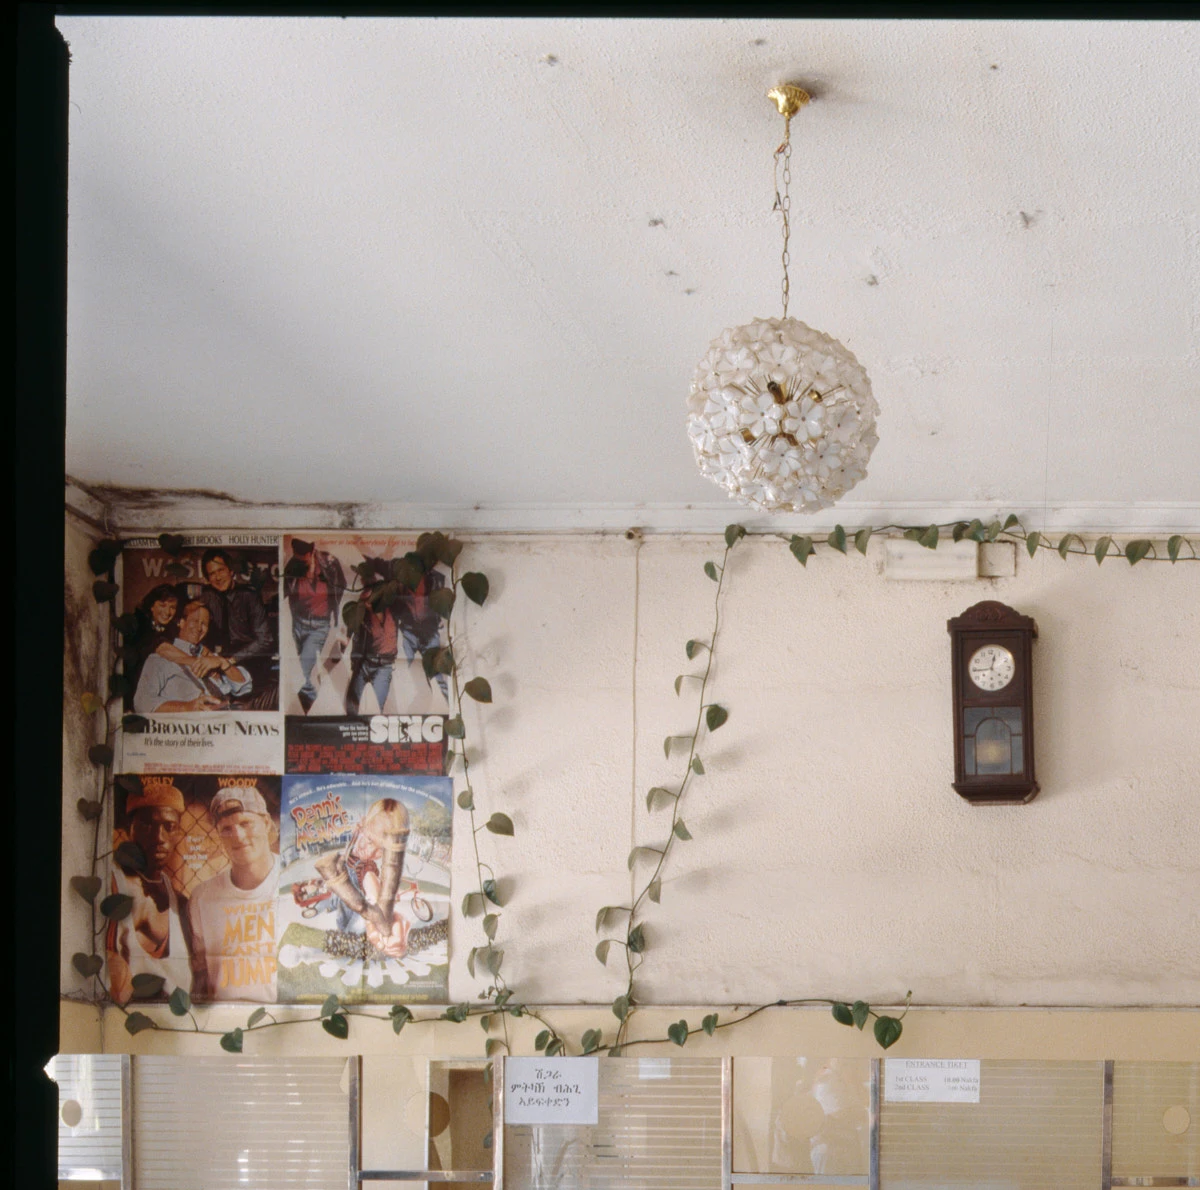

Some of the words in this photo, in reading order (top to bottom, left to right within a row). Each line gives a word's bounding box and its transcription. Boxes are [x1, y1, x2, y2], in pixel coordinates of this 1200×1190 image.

[195, 536, 222, 545] BROOKS
[229, 535, 250, 545] HOLLY
[251, 535, 279, 545] HUNTER
[145, 719, 229, 736] BROADCAST
[235, 720, 280, 736] NEWS
[370, 715, 444, 743] SING
[153, 737, 164, 746] the
[164, 739, 179, 748] story
[180, 737, 187, 746] of
[187, 738, 201, 747] their
[218, 777, 258, 788] WOODY
[291, 791, 343, 828] Dennis
[222, 900, 274, 915] WHITE
[222, 911, 275, 946] MEN
[220, 956, 277, 988] JUMP
[905, 1060, 944, 1069] ENTRANCE
[947, 1061, 968, 1069] TIKET
[907, 1083, 930, 1091] CLASS
